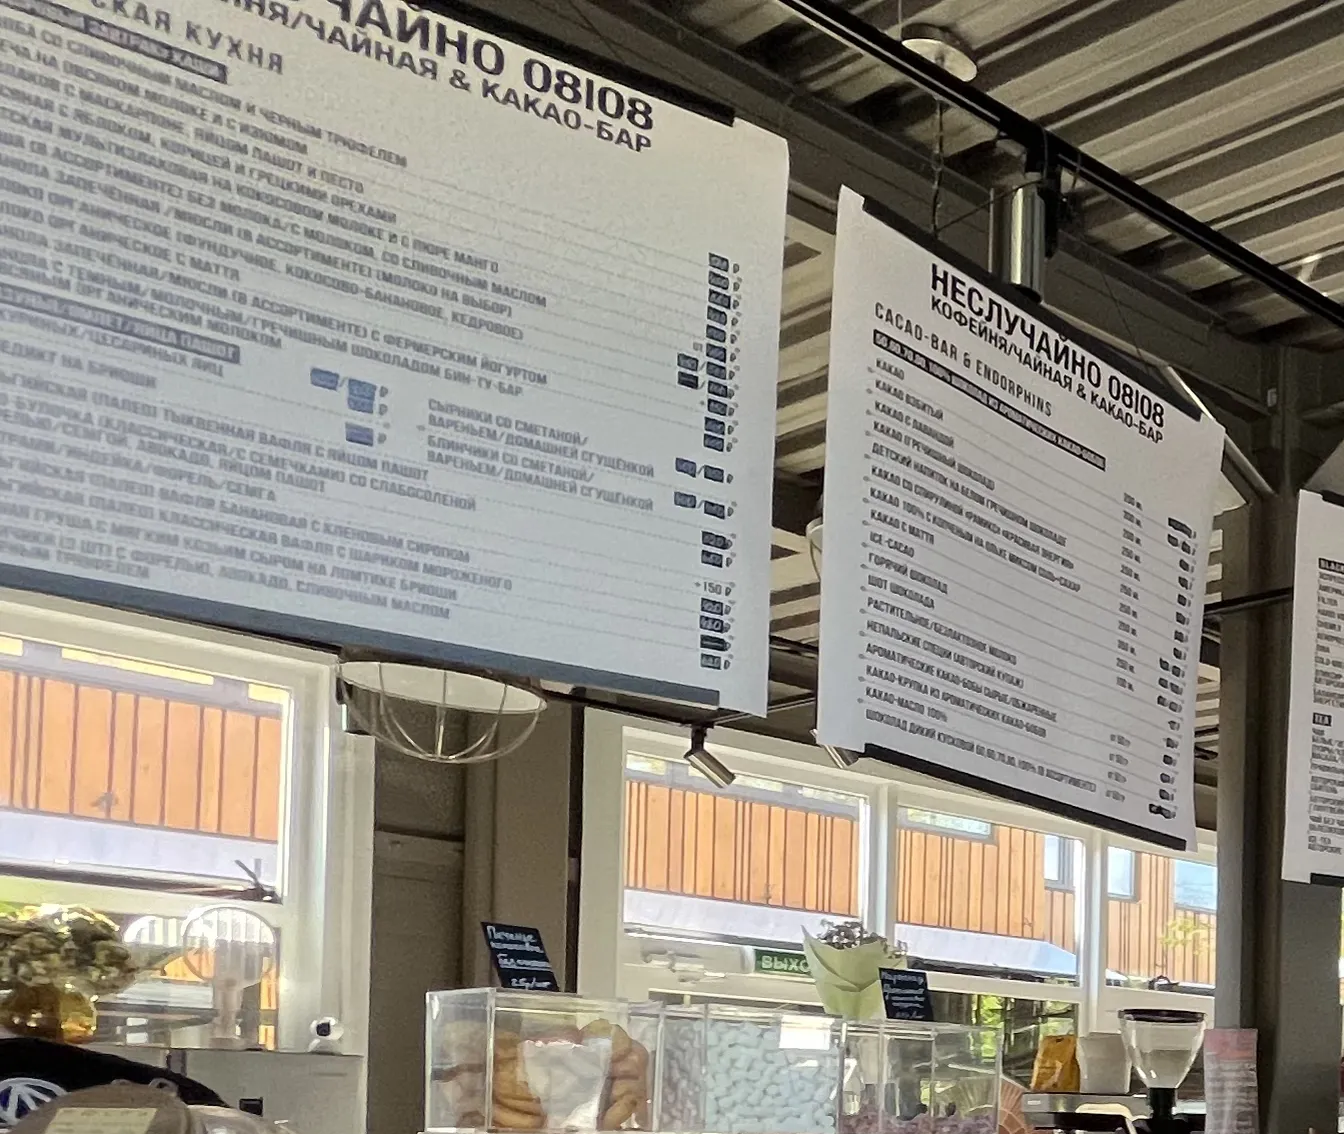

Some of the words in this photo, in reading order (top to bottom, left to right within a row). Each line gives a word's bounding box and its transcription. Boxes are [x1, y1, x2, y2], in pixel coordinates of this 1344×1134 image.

[185, 20, 284, 75] КУХНЯ
[449, 67, 471, 92] &
[481, 78, 651, 153] КАКАО-БАР
[930, 260, 1101, 393] НЕСЛУЧАЙНО
[874, 300, 957, 363] CACAO-BAR
[975, 359, 1052, 419] ENDORPHINS
[876, 356, 904, 381] КАКАО
[930, 293, 1072, 394] КОФЕЙНЯ/ЧАЙНАЯ
[1076, 381, 1087, 402] &
[1090, 390, 1163, 448] КАКАО-БАР
[875, 376, 904, 402] КАКАО
[873, 418, 902, 443] КАКАО
[874, 398, 903, 423] КАКАО
[870, 506, 900, 530] КАКАО
